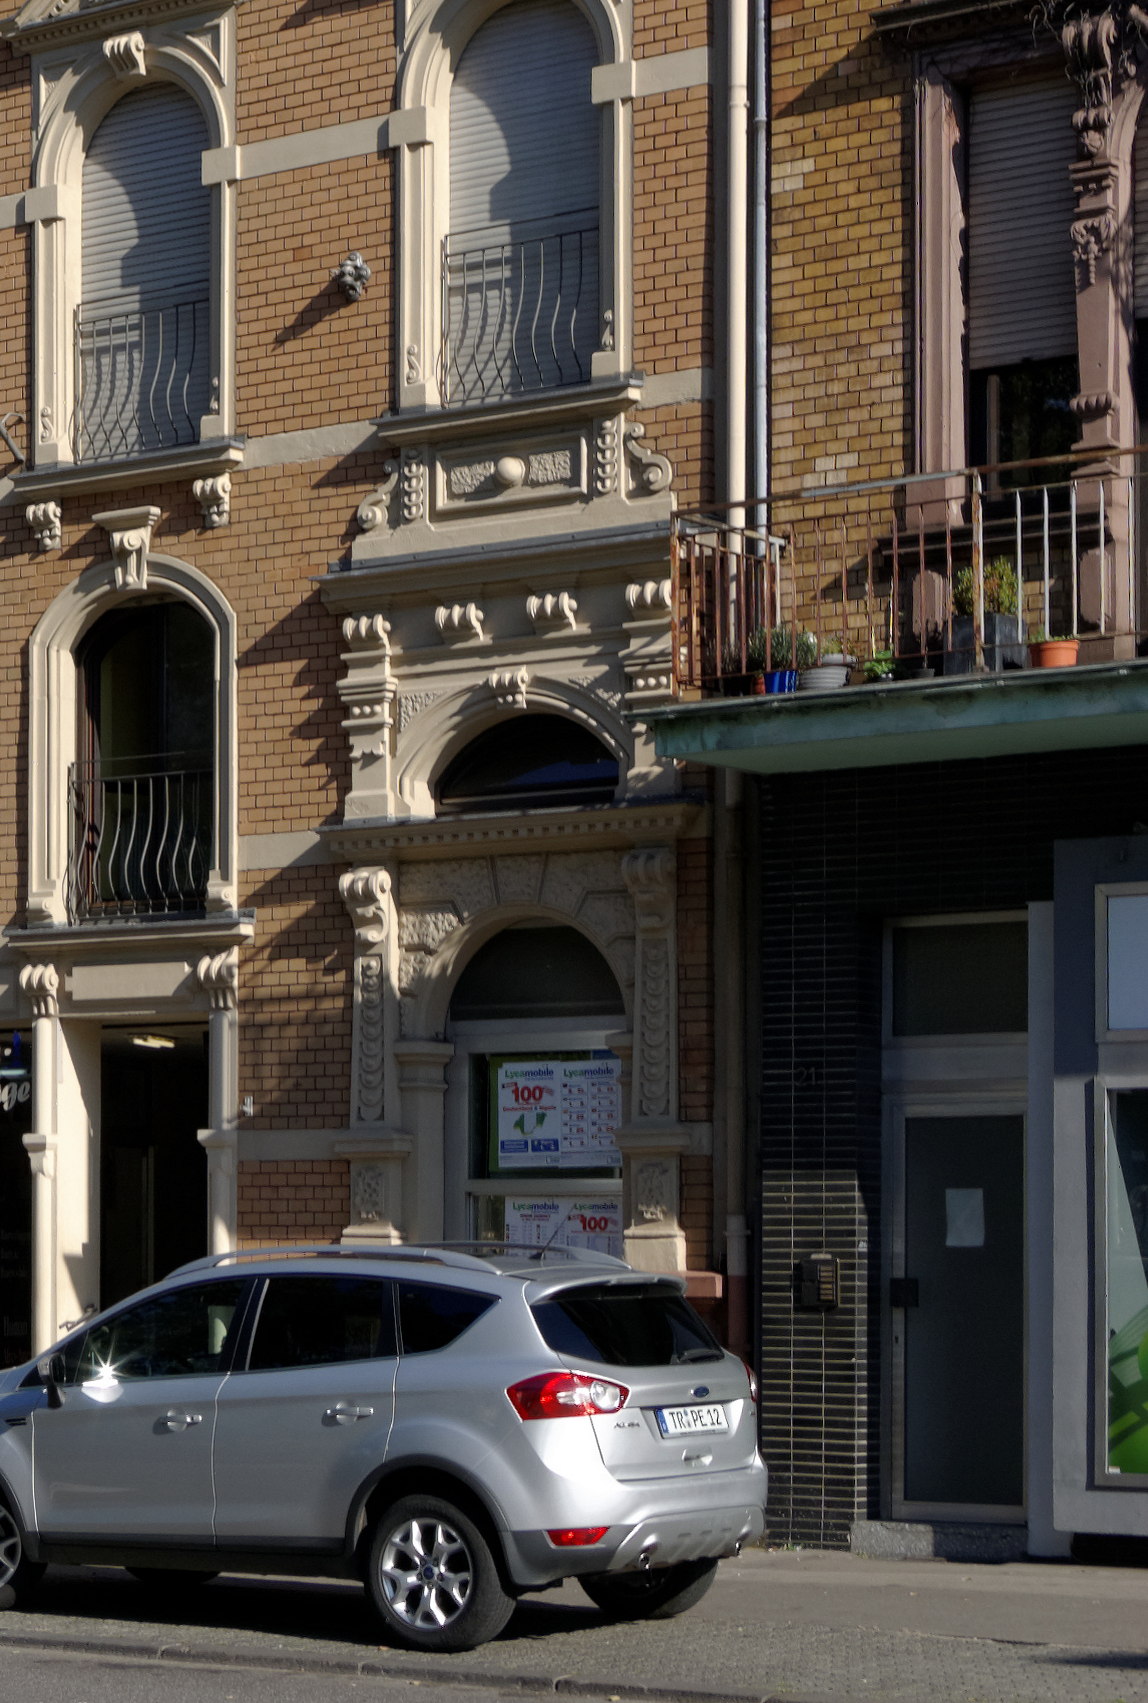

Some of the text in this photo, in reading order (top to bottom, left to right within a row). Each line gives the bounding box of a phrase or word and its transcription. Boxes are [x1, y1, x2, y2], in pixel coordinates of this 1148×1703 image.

[505, 1066, 554, 1078] Lycamobile
[563, 1066, 614, 1077] Lycamobile
[796, 1068, 816, 1086] 21
[512, 1082, 544, 1103] 100
[513, 1202, 559, 1211] Lycamobile
[580, 1214, 608, 1231] 100
[669, 1407, 722, 1429] TR PE 12
